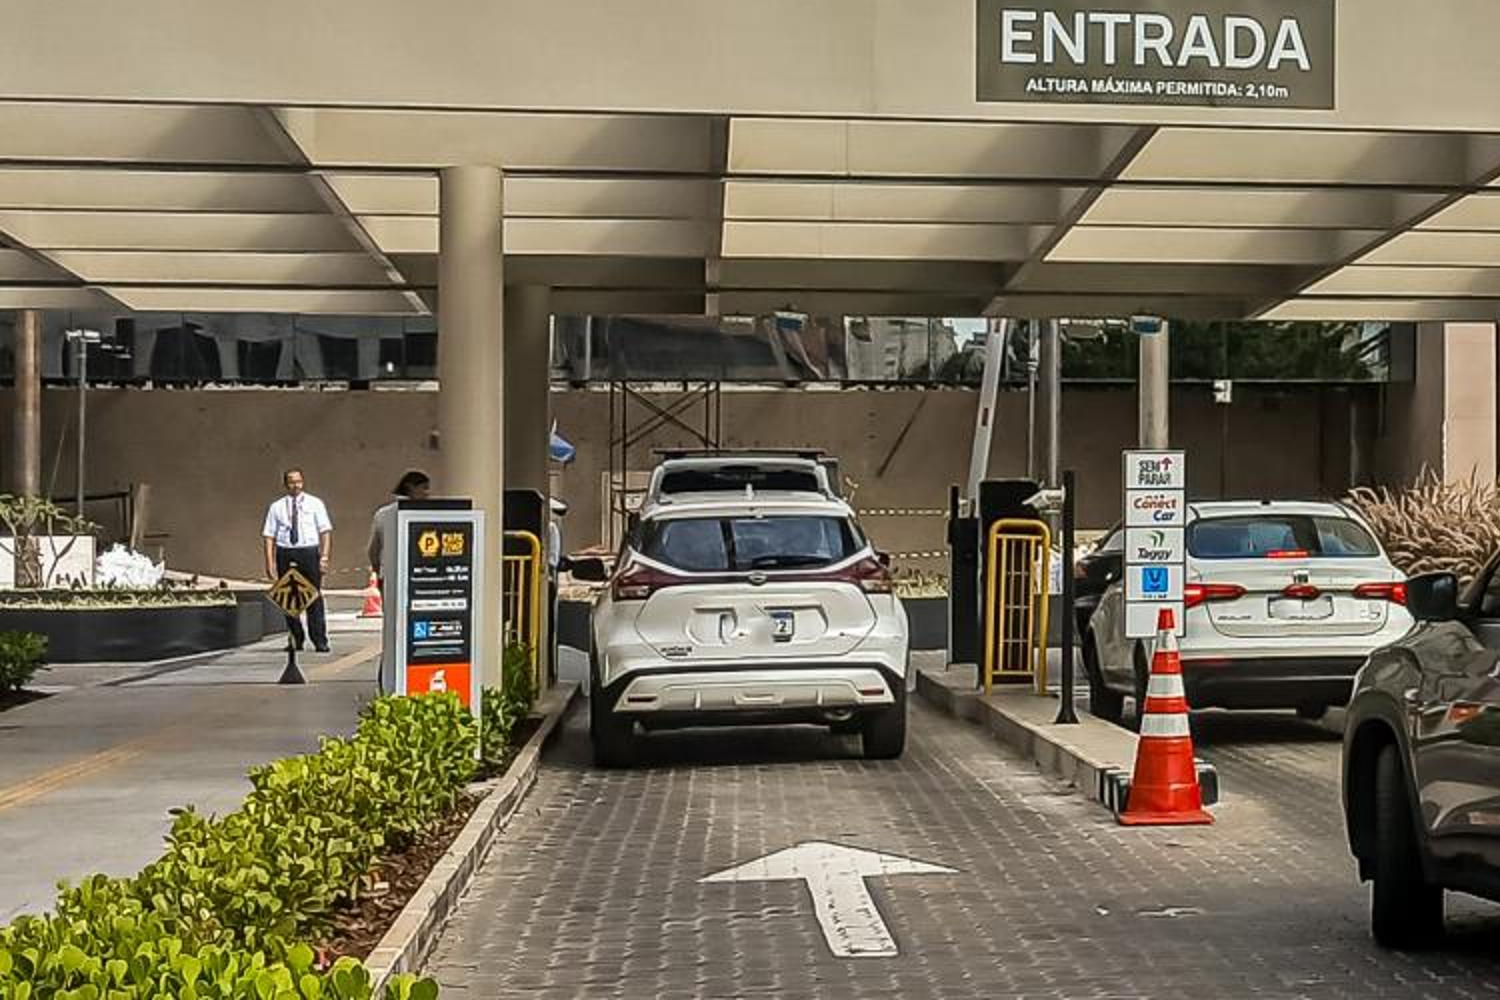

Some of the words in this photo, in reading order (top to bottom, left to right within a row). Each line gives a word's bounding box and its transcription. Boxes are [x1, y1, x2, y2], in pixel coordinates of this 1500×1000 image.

[1001, 9, 1311, 71] ENTRADA
[1026, 78, 1089, 92] ALTURA
[1091, 76, 1153, 93] MÁXIMA
[1156, 81, 1243, 97] PERMITIDA:
[1246, 83, 1289, 99] 2,10m
[1153, 510, 1175, 521] Car
[425, 537, 435, 551] P
[1137, 547, 1173, 560] Taggy
